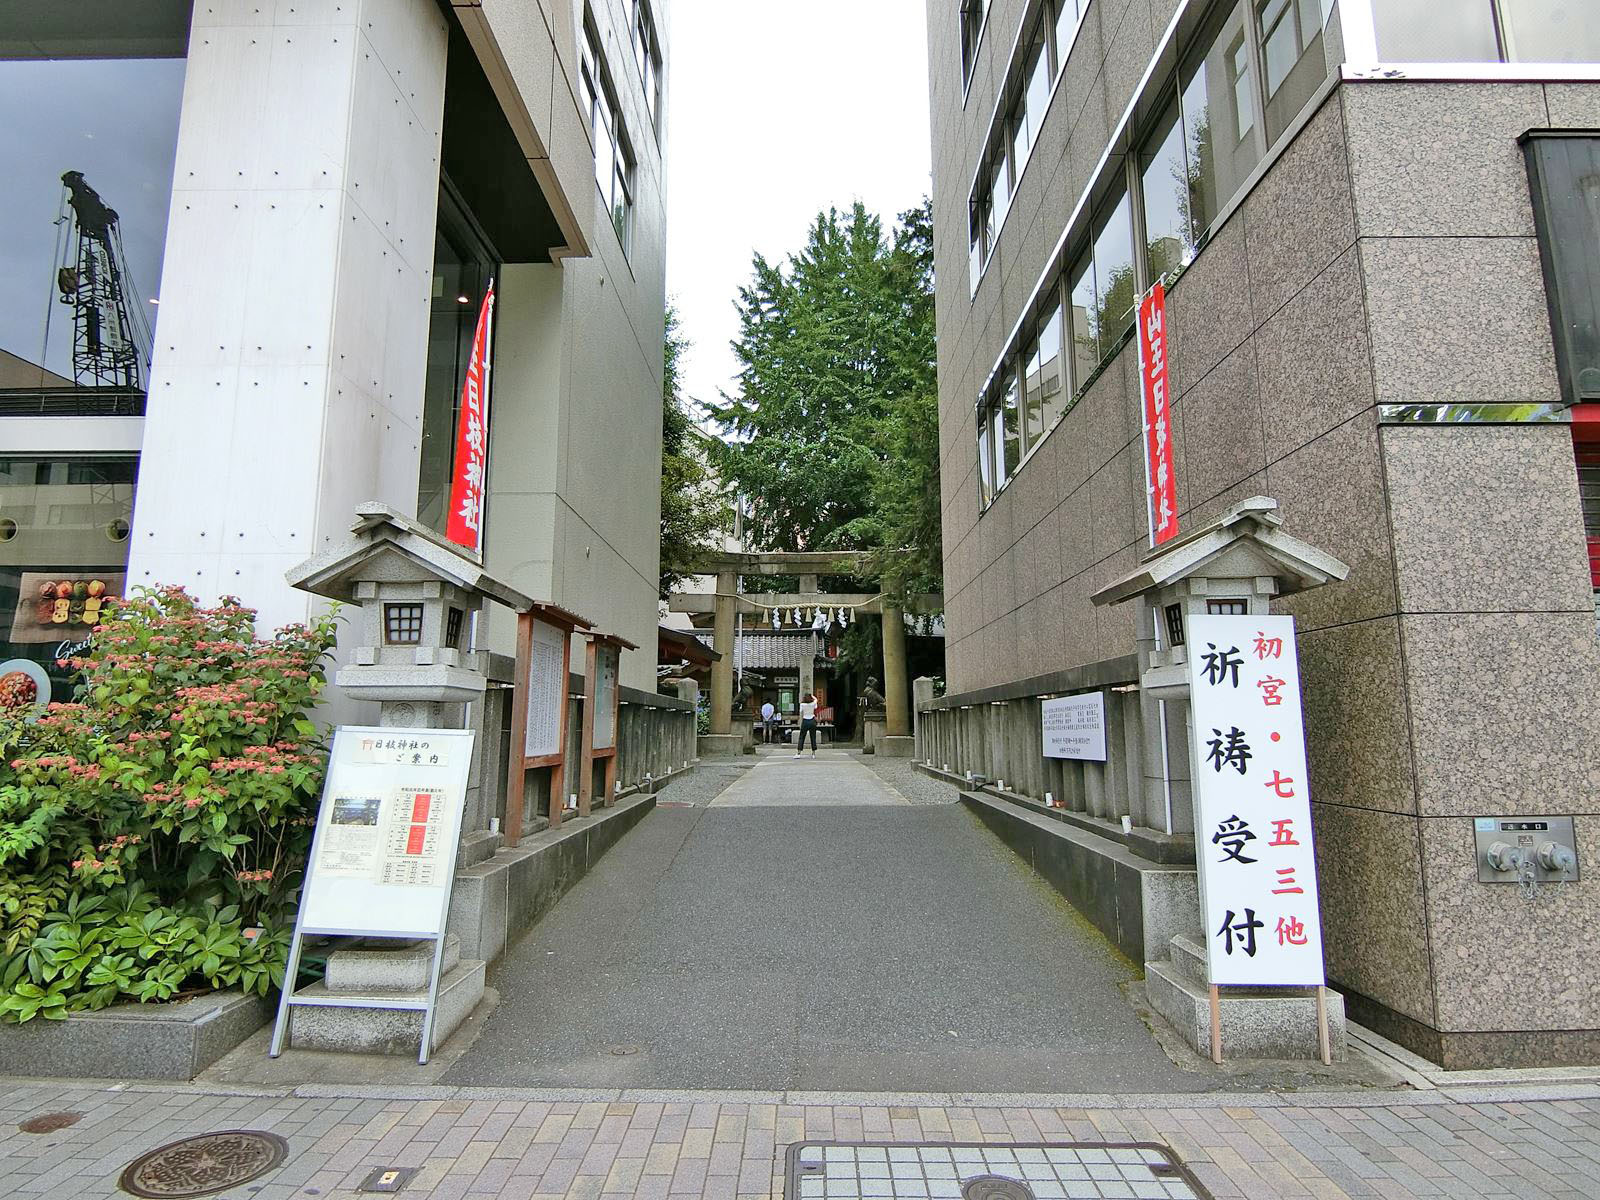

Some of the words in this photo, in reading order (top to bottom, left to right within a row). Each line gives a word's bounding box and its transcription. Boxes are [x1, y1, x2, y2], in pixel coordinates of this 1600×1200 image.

[375, 739, 430, 750] 日枝神社の
[396, 753, 439, 764] ご案内
[1199, 642, 1265, 958] 祈祷受付
[1252, 631, 1309, 946] 初宮・七五三他
